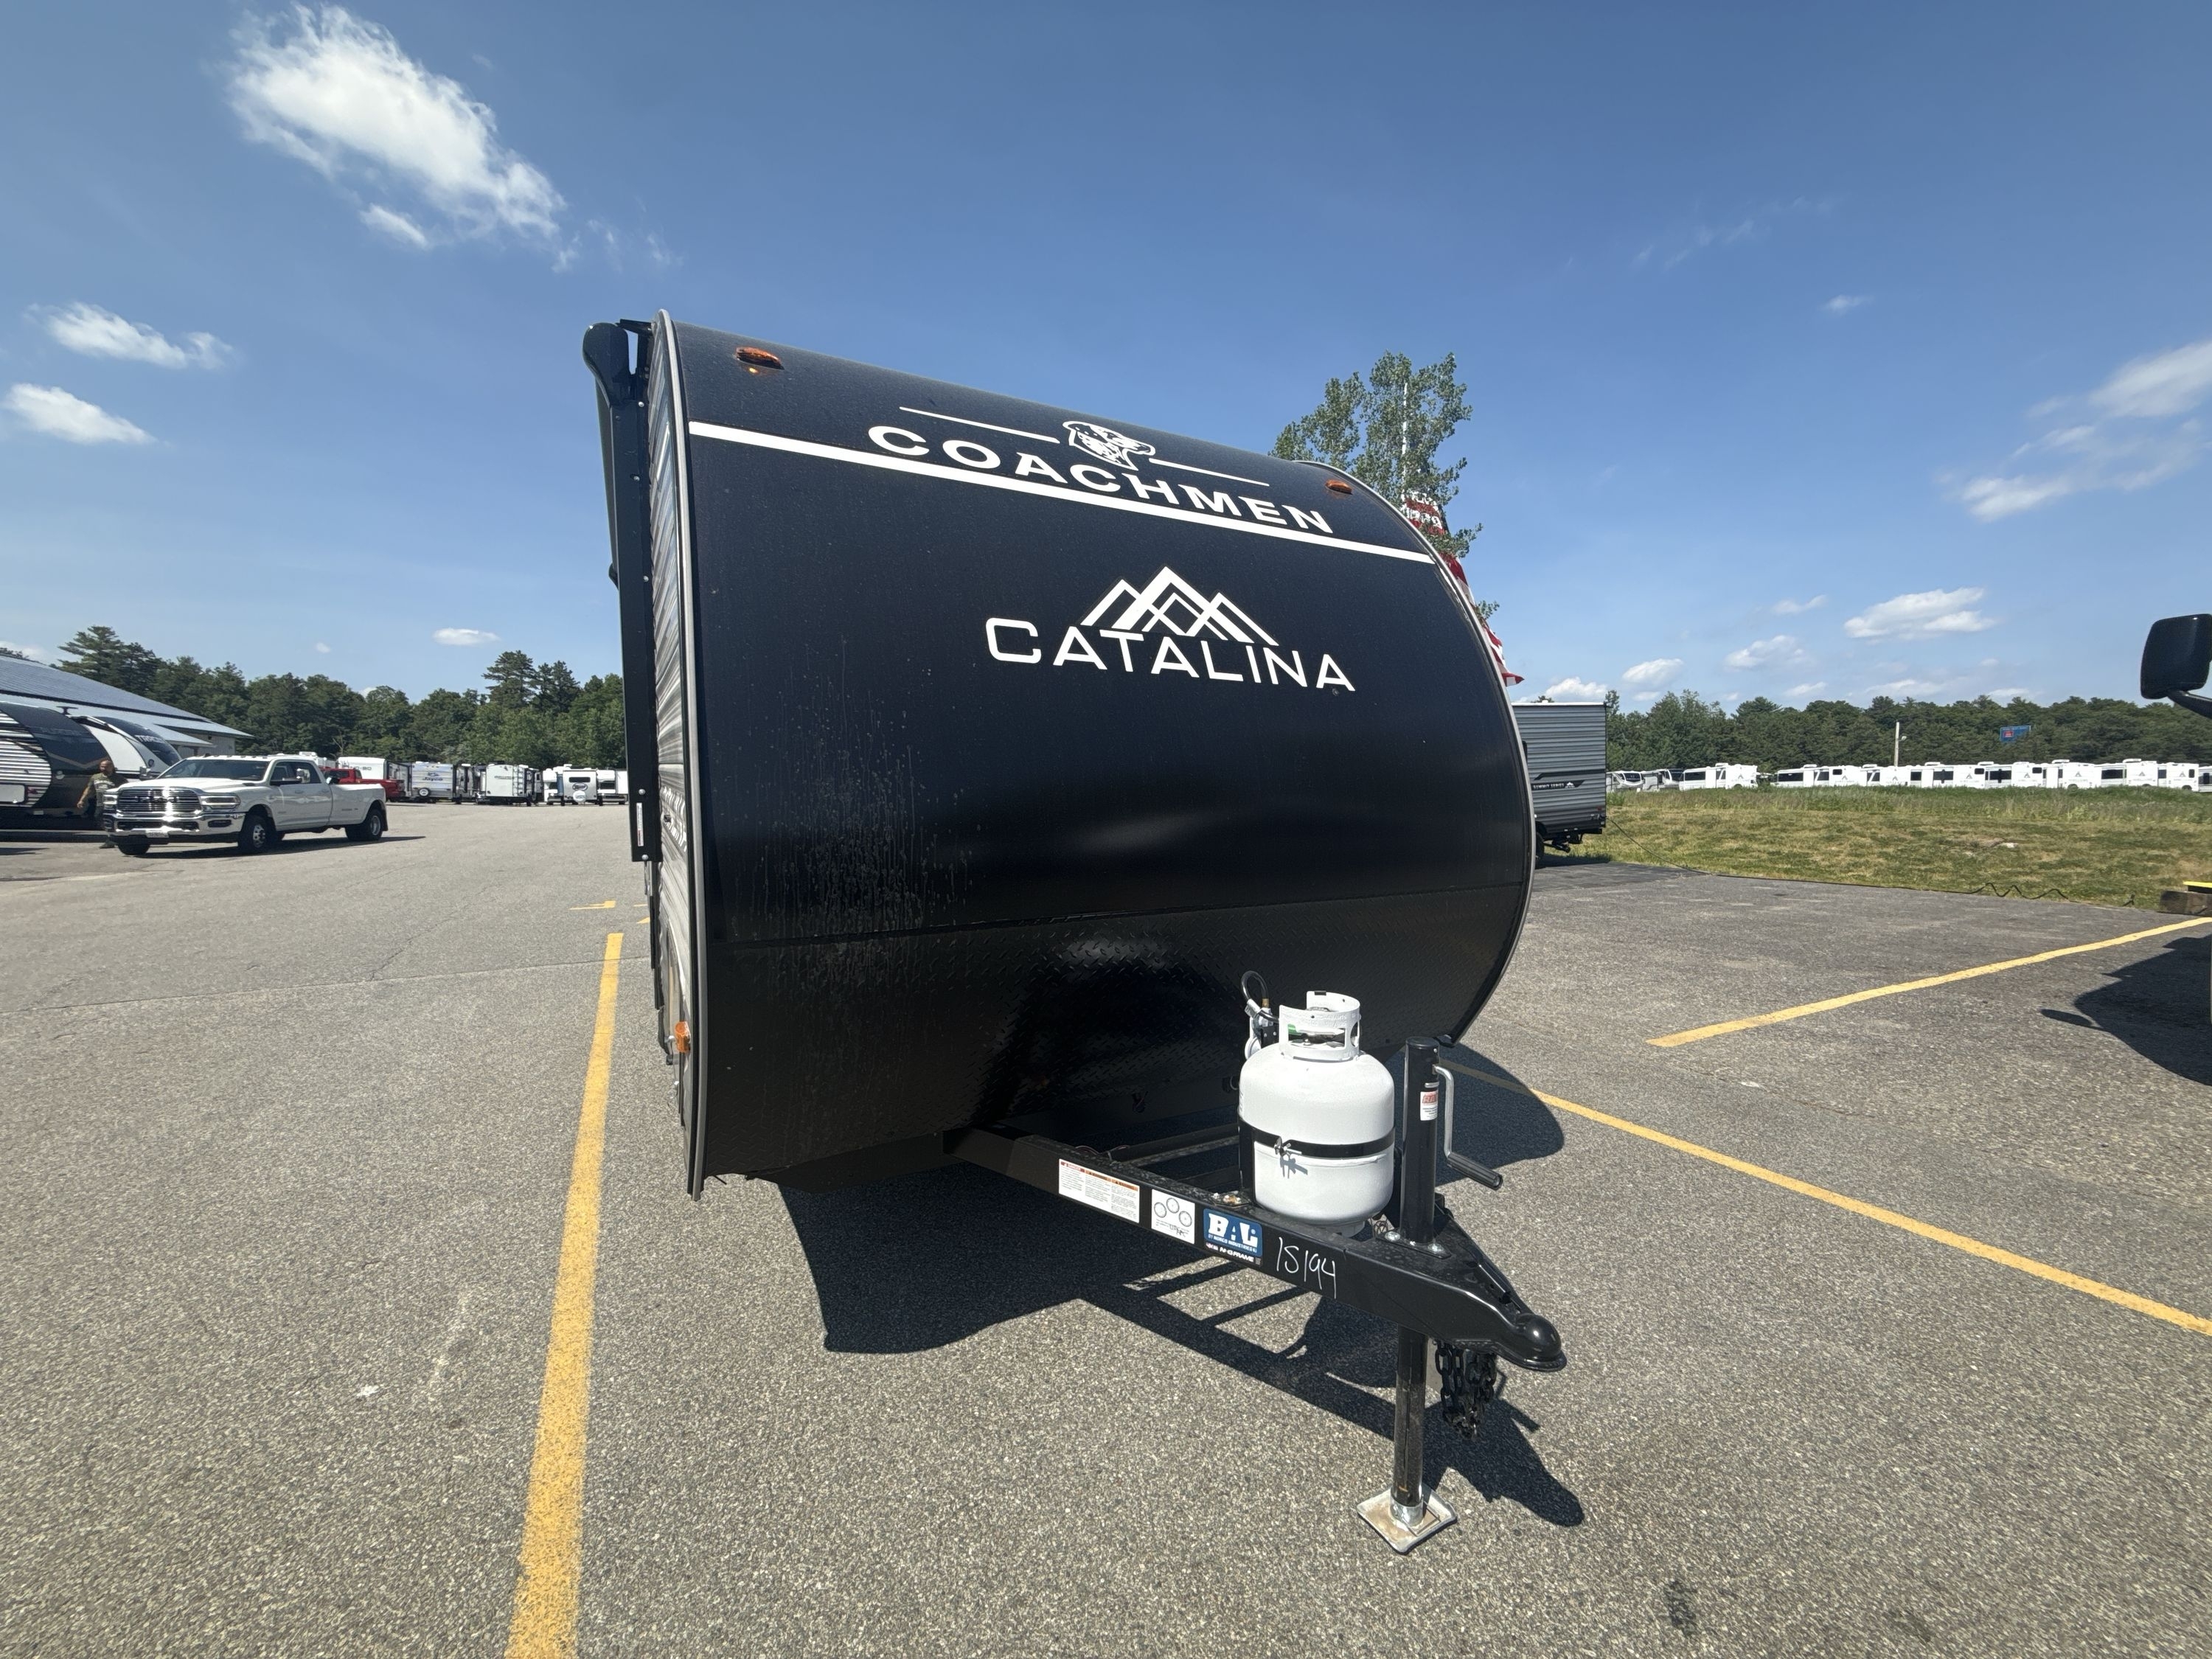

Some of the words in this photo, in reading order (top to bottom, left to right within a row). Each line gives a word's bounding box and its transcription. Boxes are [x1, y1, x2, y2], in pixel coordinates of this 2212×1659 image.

[867, 425, 1333, 534] COACHMEN
[985, 616, 1355, 692] CATALINA
[1208, 1213, 1258, 1248] BAL
[1228, 1239, 1253, 1252] INDUSTRIES
